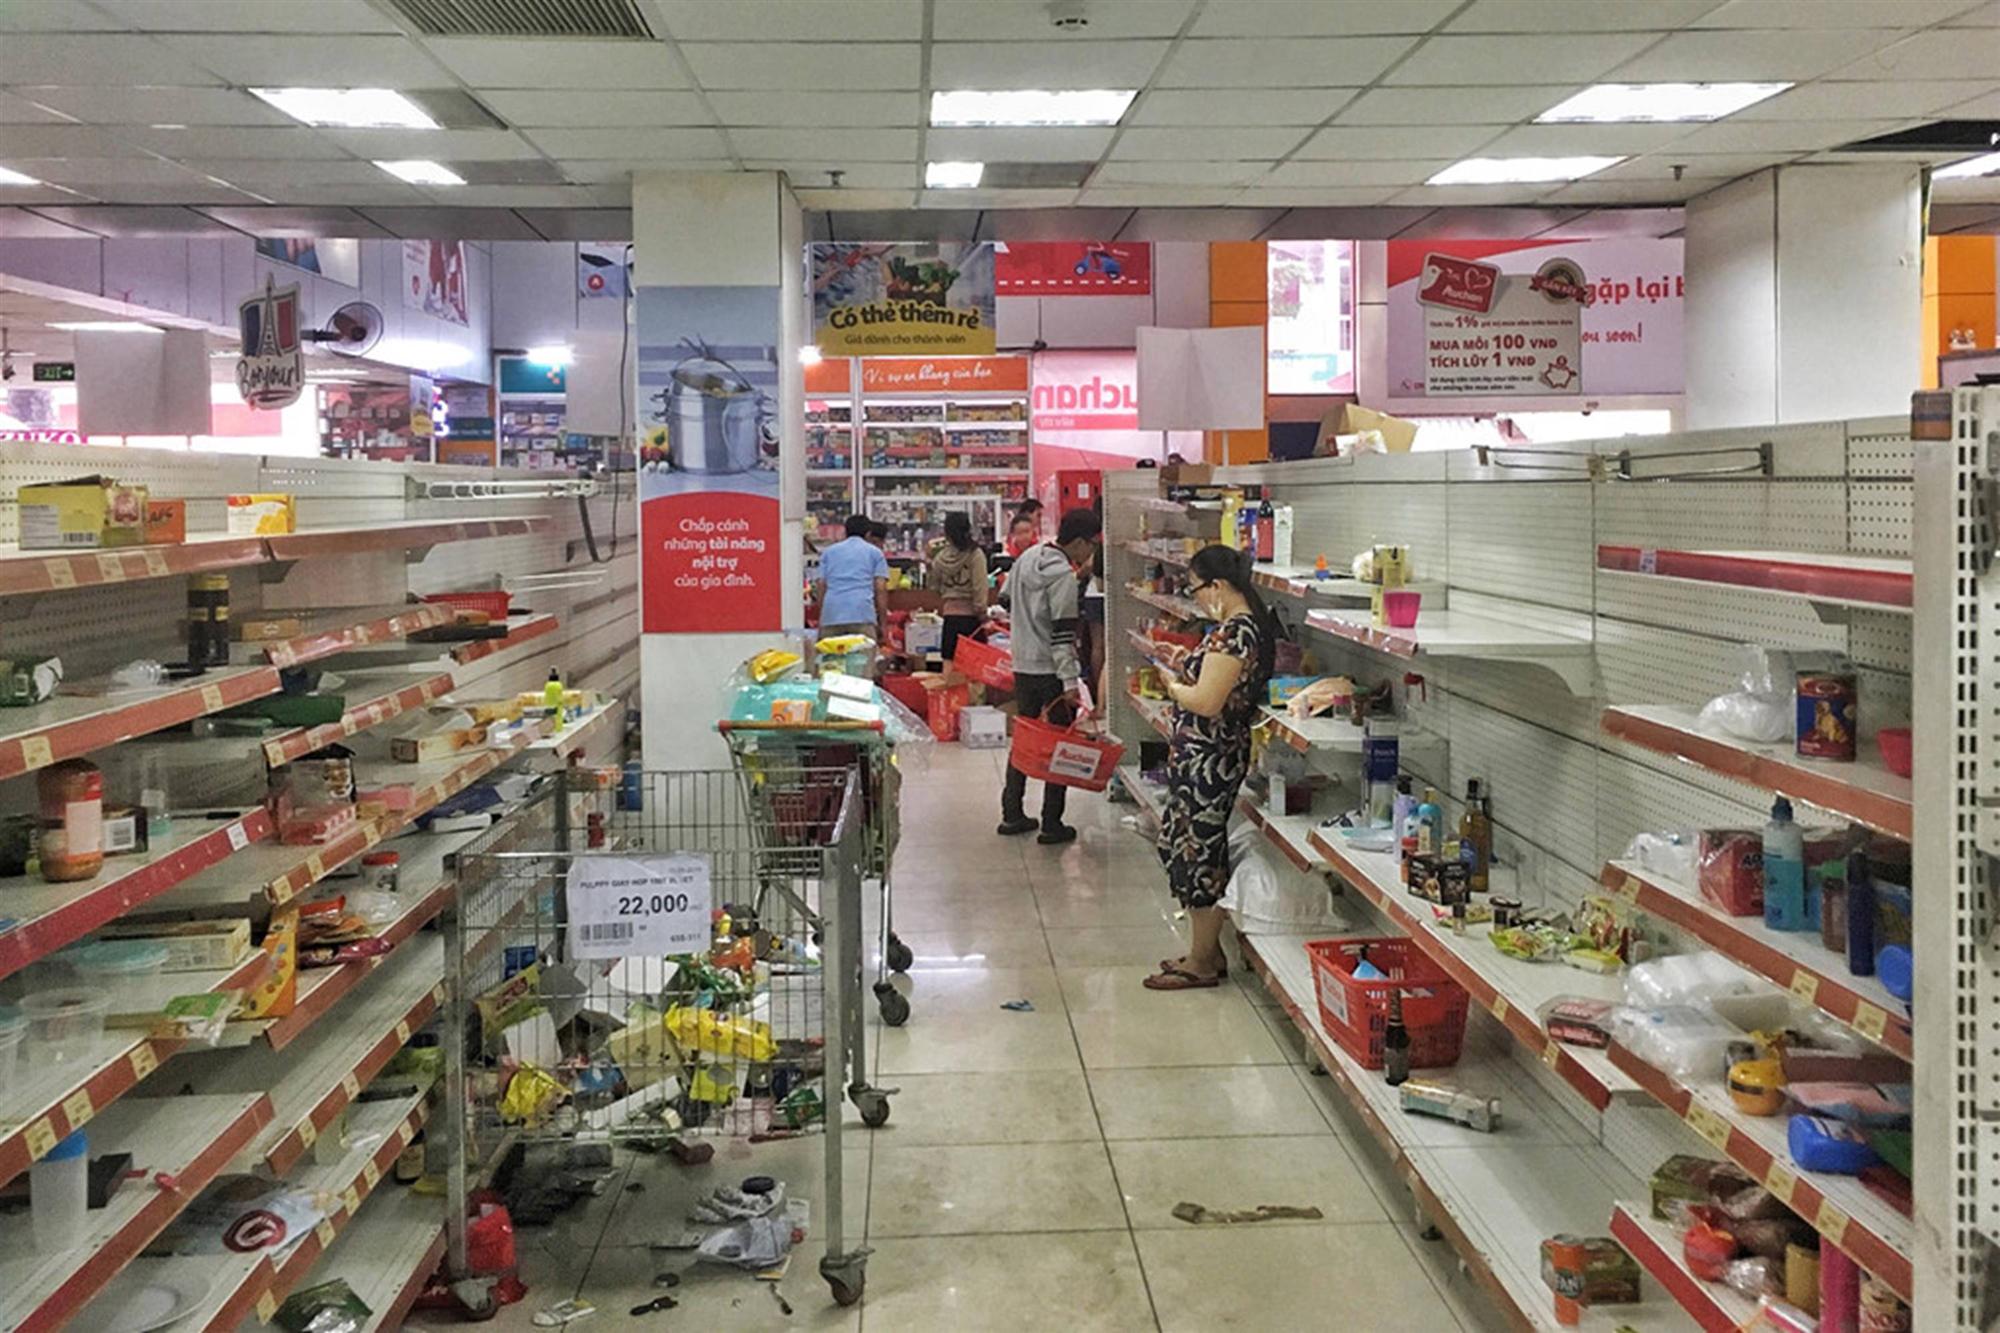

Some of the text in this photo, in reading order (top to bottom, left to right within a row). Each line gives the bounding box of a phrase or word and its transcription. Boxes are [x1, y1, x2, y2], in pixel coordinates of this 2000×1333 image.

[1441, 285, 1484, 303] Auchan
[1636, 275, 1669, 303] lại
[830, 302, 979, 329] Có thẻ thêm rẻ
[1455, 315, 1479, 328] 1%
[893, 335, 910, 344] cho
[1582, 321, 1643, 343] ou soon!
[1430, 339, 1460, 350] MUA
[1492, 334, 1525, 349] 100
[1429, 354, 1460, 368] TÍCH
[1492, 352, 1502, 366] 1
[236, 353, 299, 398] Bonjour!
[717, 518, 749, 531] cánh
[664, 536, 765, 553] những tài năng
[692, 555, 714, 571] nội
[674, 573, 698, 587] của
[700, 574, 721, 590] gia
[618, 893, 688, 916] 22,000
